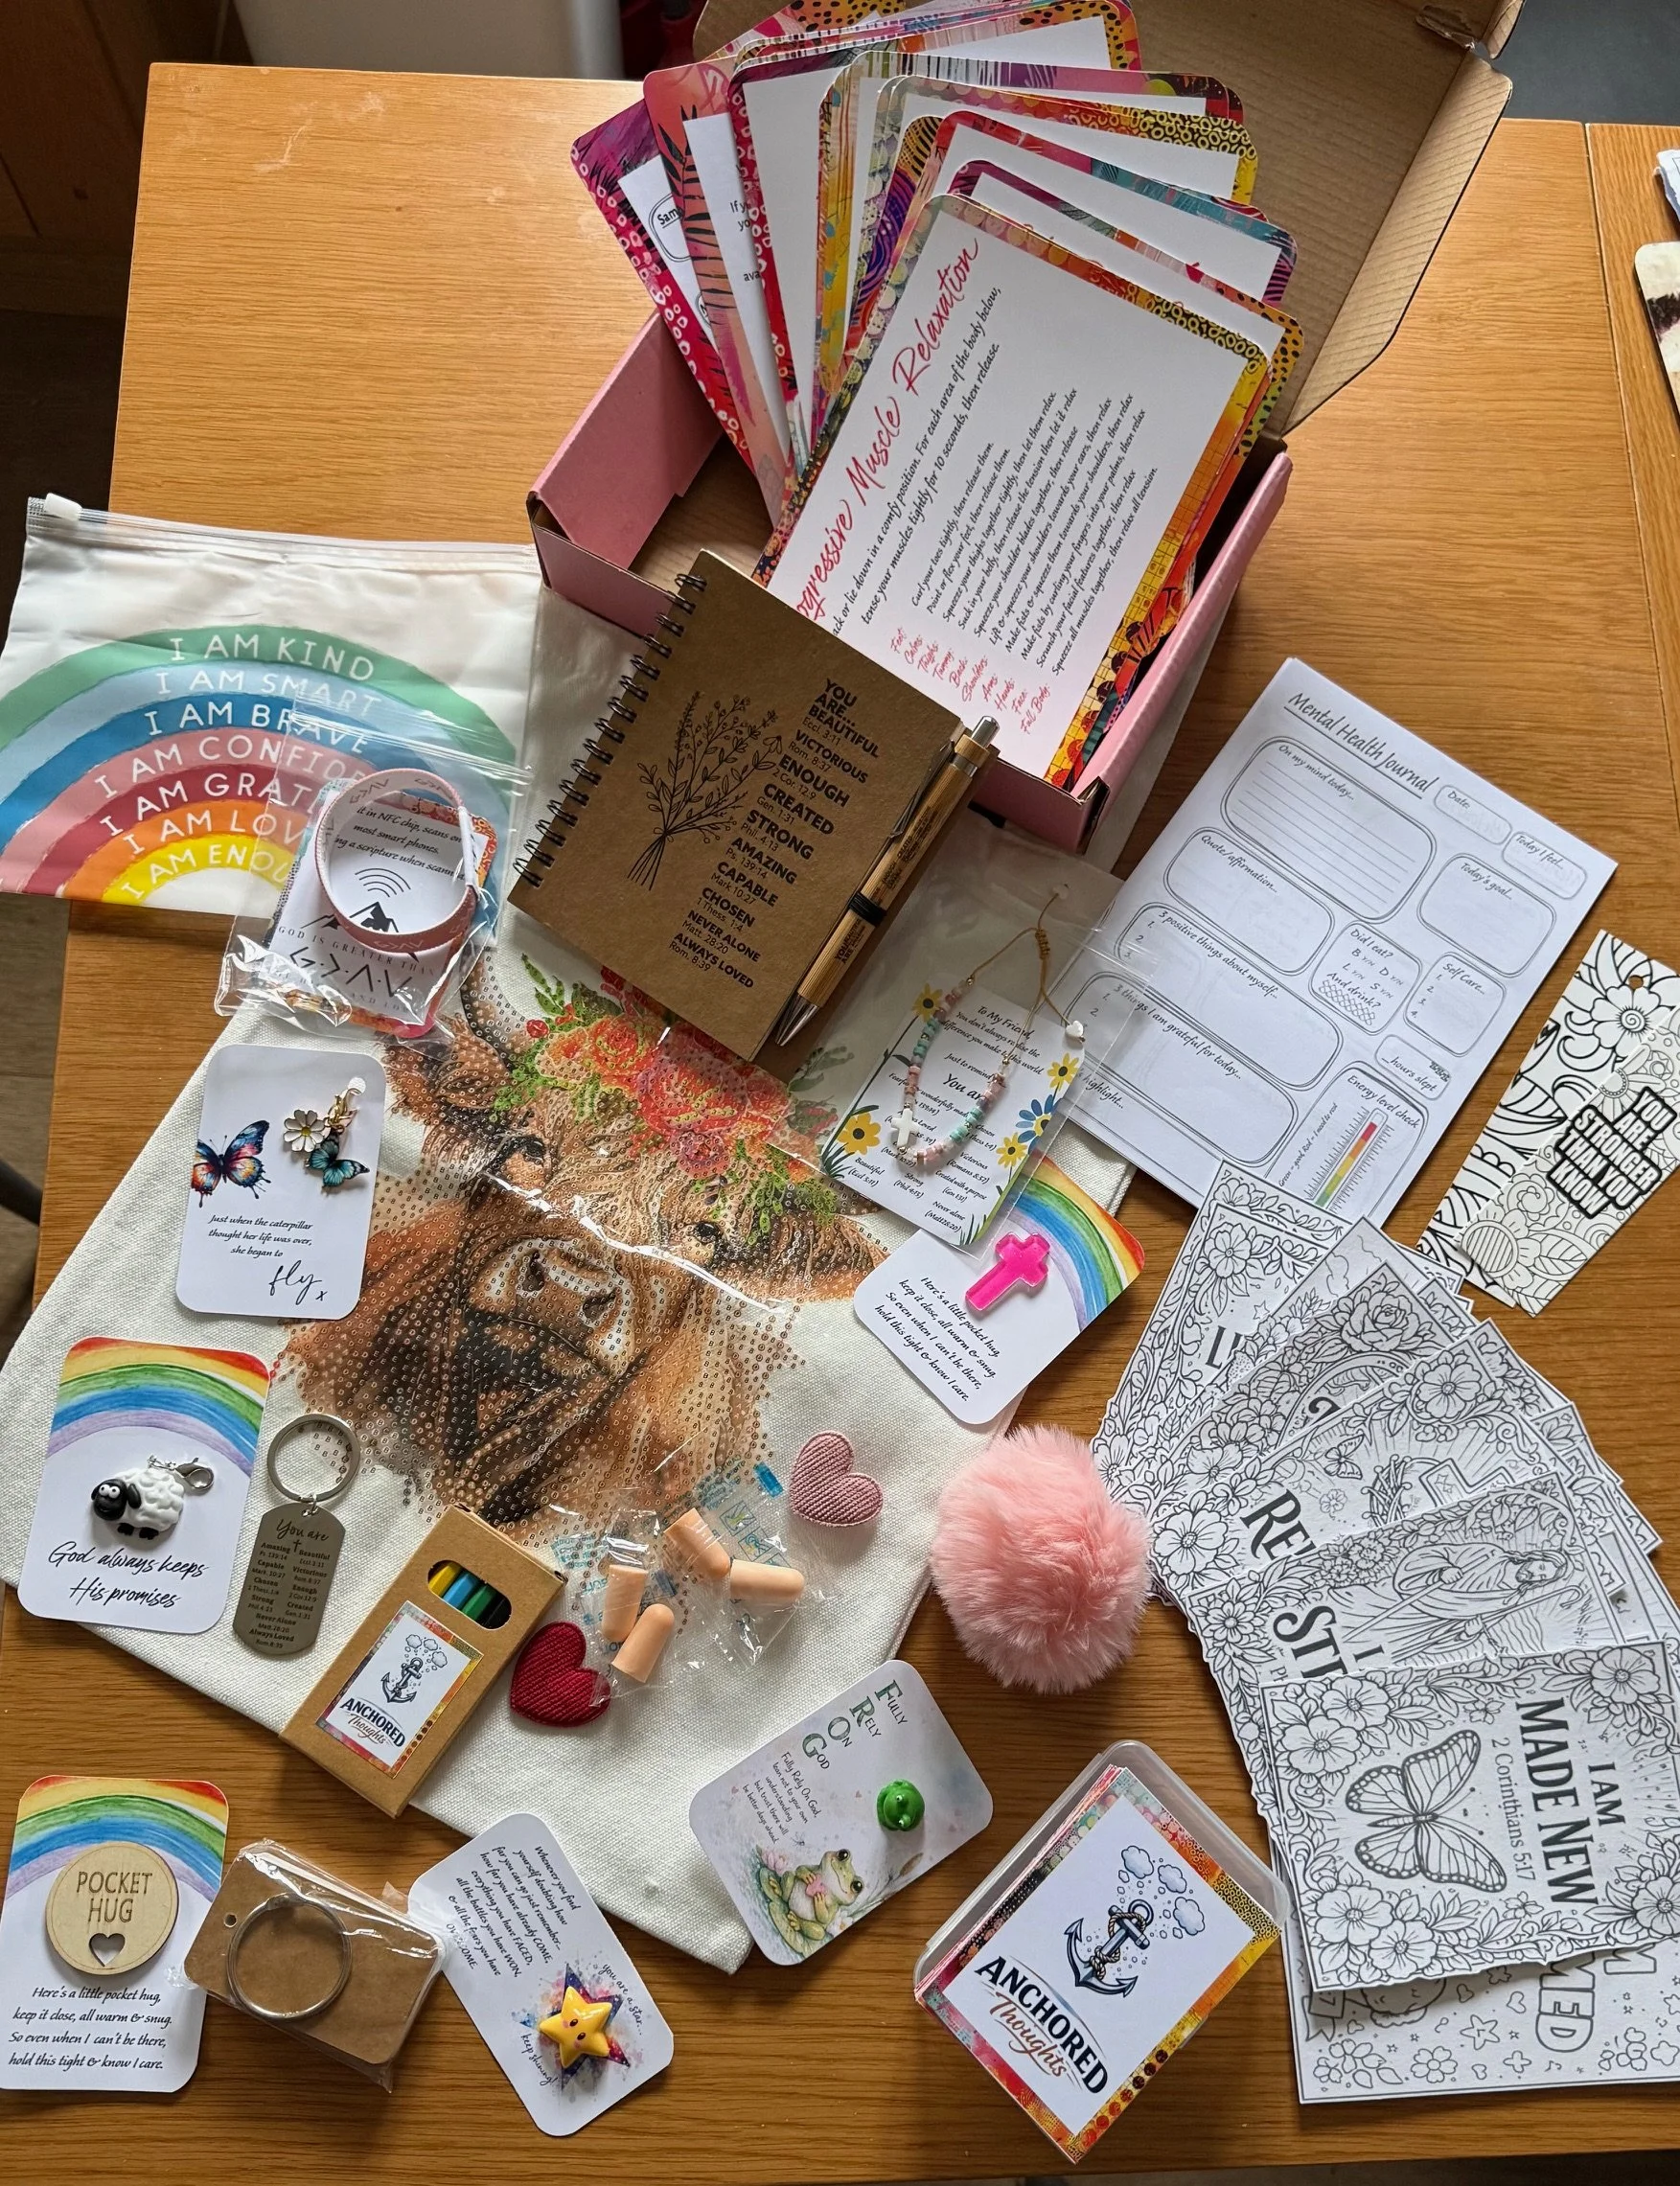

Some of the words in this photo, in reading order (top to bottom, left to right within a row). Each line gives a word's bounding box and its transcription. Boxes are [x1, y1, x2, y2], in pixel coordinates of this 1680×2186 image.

[981, 288, 1001, 318] below,
[969, 316, 986, 350] body
[845, 396, 901, 506] Muscle
[892, 239, 979, 397] Relaxation
[952, 364, 965, 383] of
[958, 349, 970, 369] the
[940, 383, 955, 408] area
[928, 407, 943, 435] each
[915, 434, 930, 456] For
[895, 459, 921, 507] position.
[882, 500, 902, 536] comfy
[871, 545, 880, 559] in
[856, 557, 874, 590] down
[841, 600, 850, 618] or
[848, 587, 858, 603] lie
[834, 615, 844, 635] ack
[170, 637, 185, 660] I
[204, 634, 258, 659] AM
[278, 638, 375, 680] KIND
[157, 673, 168, 693] I
[190, 671, 244, 691] AM
[262, 673, 382, 716] SMART
[815, 693, 856, 726] ARE...
[824, 679, 858, 708] YOU
[145, 711, 161, 734] I
[179, 702, 233, 727] AM
[252, 703, 368, 753] BRAVE
[802, 718, 821, 732] Eccl.
[822, 728, 841, 746] 3:11
[808, 705, 880, 758] BEAUTIFUL
[1288, 693, 1342, 730] Mental
[1337, 724, 1385, 761] Health
[1380, 753, 1439, 793] Journal
[95, 775, 116, 798] I
[131, 744, 181, 779] AM
[789, 741, 811, 760] Rom.
[811, 753, 832, 771] 8:37
[794, 729, 869, 784] VICTORIOUS
[1278, 745, 1291, 756] On
[1293, 753, 1306, 767] my
[1306, 762, 1327, 780] mind
[1327, 778, 1354, 800] today...
[779, 753, 850, 807] ENOUGH
[101, 816, 123, 836] I
[136, 782, 188, 819] AM
[764, 783, 834, 834] CREATED
[1447, 791, 1470, 809] Date:
[125, 833, 144, 855] I
[160, 812, 212, 842] AM
[354, 824, 377, 837] most
[379, 831, 406, 844] smart
[408, 840, 438, 855] phones.
[378, 813, 400, 824] NFC
[401, 818, 421, 833] chip,
[423, 826, 447, 839] scans
[748, 809, 814, 859] STRONG
[122, 881, 143, 900] I
[148, 849, 196, 885] AM
[731, 838, 797, 884] AMAZING
[1201, 835, 1277, 893] Quote/affirmation...
[711, 872, 732, 889] Mark
[733, 886, 756, 905] 10:27
[718, 863, 778, 907] CAPABLE
[1461, 863, 1490, 886] Today's
[1488, 882, 1512, 900] goal...
[702, 887, 755, 928] CHOSEN
[278, 926, 305, 939] GOD
[312, 934, 325, 945] IS
[333, 941, 393, 965] GREATER
[687, 910, 724, 939] NEVER
[723, 934, 761, 962] ALONE
[674, 932, 719, 965] ALWAYS
[718, 960, 754, 988] LOVED
[1159, 910, 1167, 919] 3
[1163, 915, 1198, 940] positive
[1196, 935, 1224, 959] things
[1223, 955, 1248, 978] about
[1247, 972, 1277, 1000] myself...
[1443, 963, 1459, 979] Self
[1461, 974, 1484, 995] Care...
[978, 1005, 991, 1016] To
[988, 1011, 1005, 1026] My
[1003, 1017, 1035, 1041] Friend,
[942, 1073, 966, 1094] You
[1390, 1057, 1415, 1077] hours
[1415, 1074, 1438, 1093] slept
[1347, 1075, 1376, 1100] Energy
[1375, 1094, 1394, 1112] level
[1395, 1110, 1419, 1129] check
[1633, 1091, 1673, 1132] YOU
[1613, 1113, 1656, 1149] ARE
[1574, 1107, 1658, 1192] STRONGER
[1558, 1129, 1608, 1179] THAN
[1598, 1166, 1641, 1208] YOU
[1550, 1159, 1610, 1216] KNOW
[208, 1214, 228, 1224] Just
[255, 1217, 268, 1227] the
[269, 1220, 313, 1231] caterpillar
[208, 1230, 242, 1241] thought
[243, 1232, 258, 1241] her
[259, 1233, 272, 1243] life
[231, 1245, 245, 1254] she
[247, 1247, 273, 1258] began
[268, 1259, 323, 1305] fly
[315, 1290, 328, 1301] x
[921, 1277, 945, 1300] Here's
[948, 1303, 967, 1322] little
[960, 1321, 987, 1342] pocket
[984, 1339, 1001, 1358] hug,
[276, 1519, 305, 1539] You
[308, 1530, 330, 1541] are
[48, 1540, 96, 1564] God
[97, 1548, 159, 1575] always
[154, 1558, 210, 1580] keeps
[69, 1576, 109, 1606] His
[107, 1587, 183, 1609] promises
[849, 1695, 883, 1737] RELY
[874, 1679, 909, 1725] FULLY
[340, 1697, 406, 1747] ANCHORED
[347, 1713, 387, 1744] Thoughts
[827, 1716, 853, 1748] ON
[801, 1733, 830, 1769] GOD
[1490, 1736, 1505, 1750] 2
[1515, 1696, 1580, 1812] MADE
[1587, 1760, 1617, 1772] I
[1493, 1751, 1525, 1851] Corinthians
[1590, 1778, 1627, 1828] AM
[535, 1846, 561, 1886] Whenever
[557, 1879, 571, 1898] you
[566, 1895, 581, 1911] find
[1512, 1851, 1537, 1881] 5:17
[1536, 1816, 1599, 1906] NEW
[76, 1871, 153, 1895] POCKET
[88, 1898, 134, 1923] HUG
[602, 1964, 617, 1982] you
[615, 1980, 629, 1995] are
[33, 1986, 67, 1999] Here's
[68, 1990, 76, 1999] a
[78, 1986, 104, 1999] little
[104, 1989, 137, 2004] pocket
[139, 1990, 161, 2006] hug,
[627, 1996, 633, 2005] a
[628, 2006, 643, 2036] star...
[974, 1956, 1109, 2094] ANCHORED
[989, 1991, 1068, 2078] Thoughts
[520, 2033, 536, 2058] keep
[528, 2054, 558, 2085] shining!
